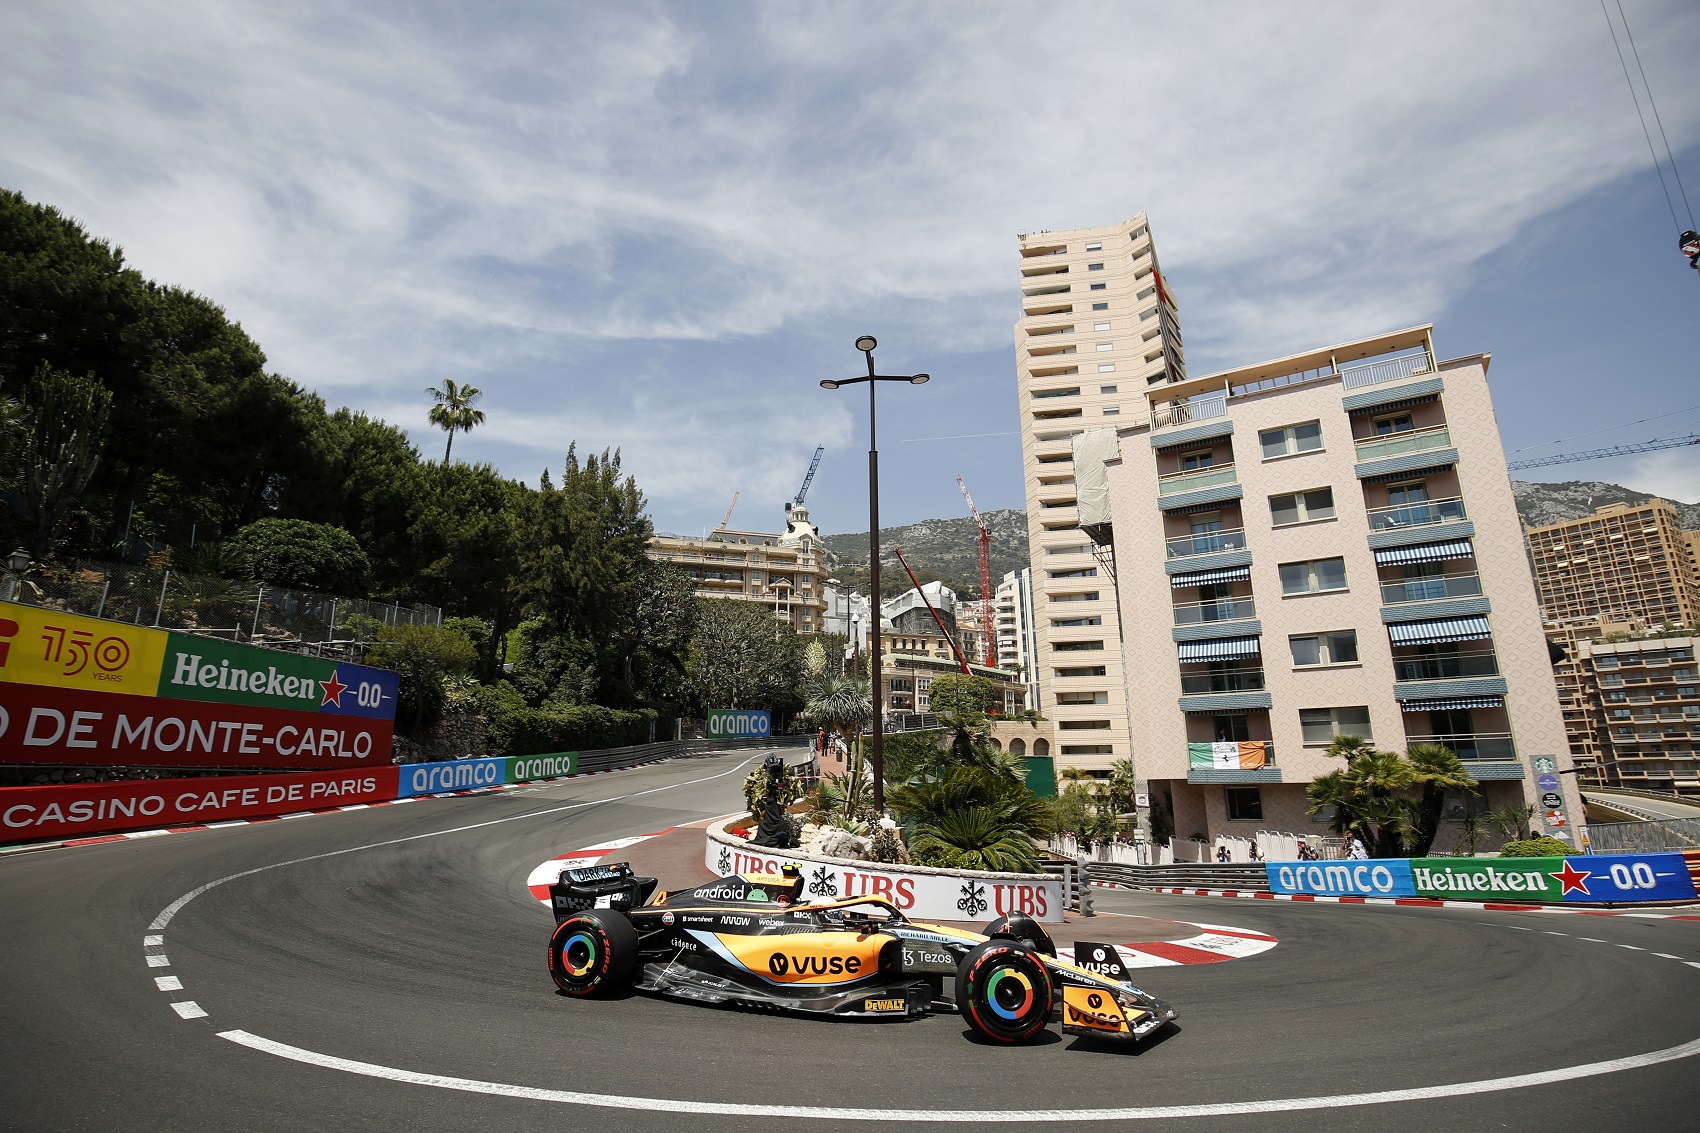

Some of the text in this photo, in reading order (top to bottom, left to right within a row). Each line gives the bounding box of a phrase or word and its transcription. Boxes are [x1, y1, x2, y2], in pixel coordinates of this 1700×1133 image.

[41, 625, 130, 676] 150
[92, 672, 123, 682] YEARS
[171, 652, 382, 708] Heineken 0.0
[23, 707, 103, 748] DE
[111, 713, 372, 758] MONTE-CARLO
[710, 714, 768, 734] aramco
[412, 762, 497, 792] aramco
[514, 756, 571, 779] aramco
[3, 777, 376, 828] CASINO CAFE DE PARIS
[1279, 865, 1394, 893] aramco
[1413, 862, 1657, 891] Heineken 0.0
[693, 884, 745, 900] android
[843, 872, 916, 910] UBS
[993, 884, 1048, 917] UBS
[758, 918, 785, 927] webex
[900, 932, 929, 940] RICHARD
[602, 939, 611, 974] ZERO
[792, 955, 862, 975] vuse
[917, 950, 952, 963] Tezos
[974, 947, 1009, 970] ZERO
[1055, 970, 1096, 986] McLaren
[1079, 962, 1120, 975] vuse
